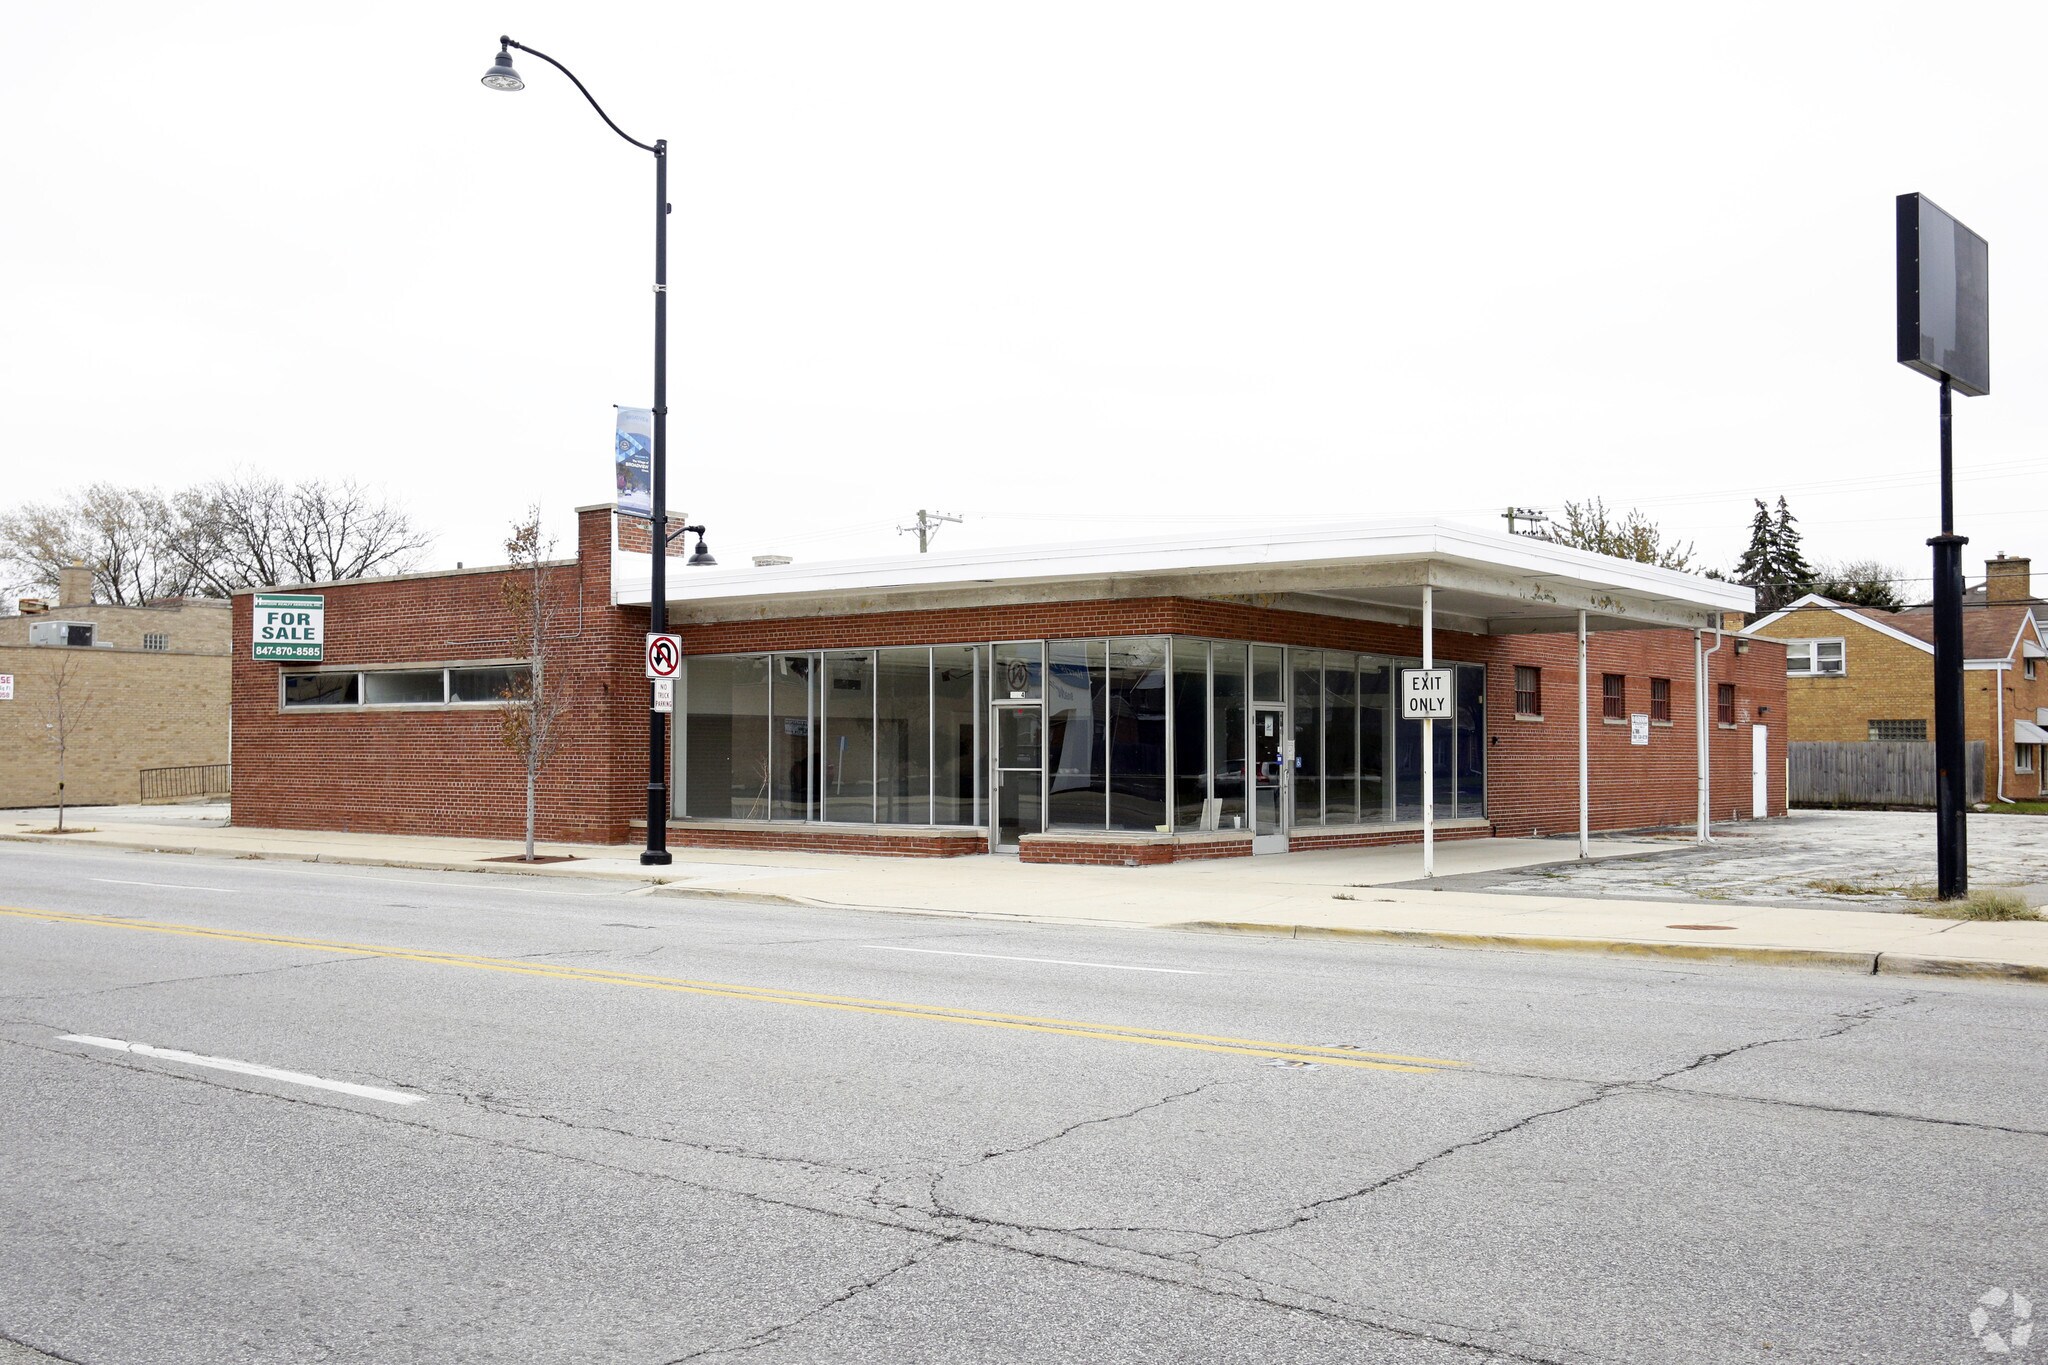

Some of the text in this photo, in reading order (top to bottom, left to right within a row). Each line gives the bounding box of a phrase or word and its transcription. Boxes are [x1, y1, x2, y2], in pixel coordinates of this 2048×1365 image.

[267, 612, 310, 625] FOR
[261, 626, 315, 640] SALE
[255, 646, 320, 656] 847-870-8585
[1412, 676, 1442, 691] EXIT
[1410, 697, 1445, 711] ONLY
